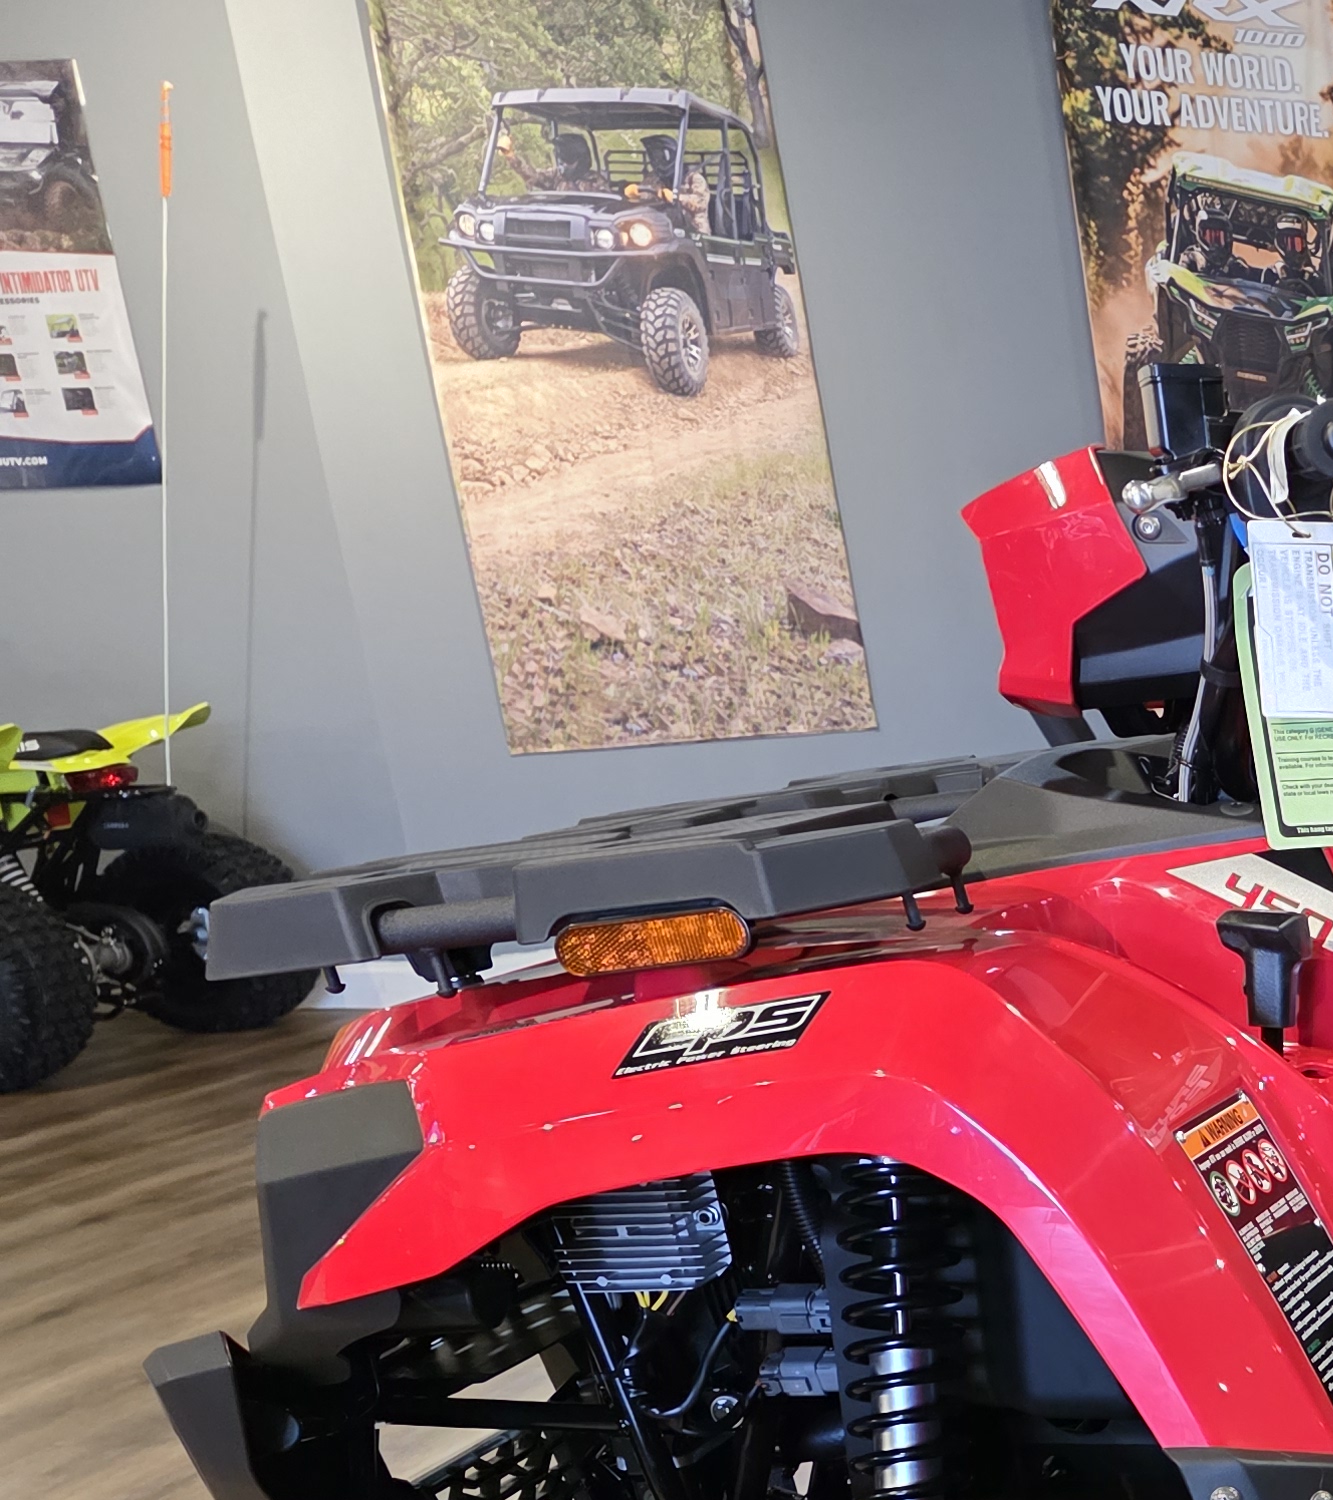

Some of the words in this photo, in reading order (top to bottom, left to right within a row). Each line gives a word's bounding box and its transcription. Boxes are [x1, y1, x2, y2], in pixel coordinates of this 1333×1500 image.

[1233, 28, 1306, 47] 1000
[1118, 43, 1195, 84] YOUR
[1200, 51, 1302, 93] WORLD.
[1095, 85, 1172, 126] YOUR
[1180, 93, 1330, 138] ADVENTURE.
[0, 270, 74, 295] INTIMIDATOR
[75, 268, 100, 292] UTV
[1317, 552, 1331, 575] DO
[1319, 583, 1333, 617] NOT
[615, 1057, 672, 1076] Electric
[676, 1049, 726, 1065] Power
[730, 1038, 798, 1056] Steering
[1205, 1108, 1244, 1141] WARNING
